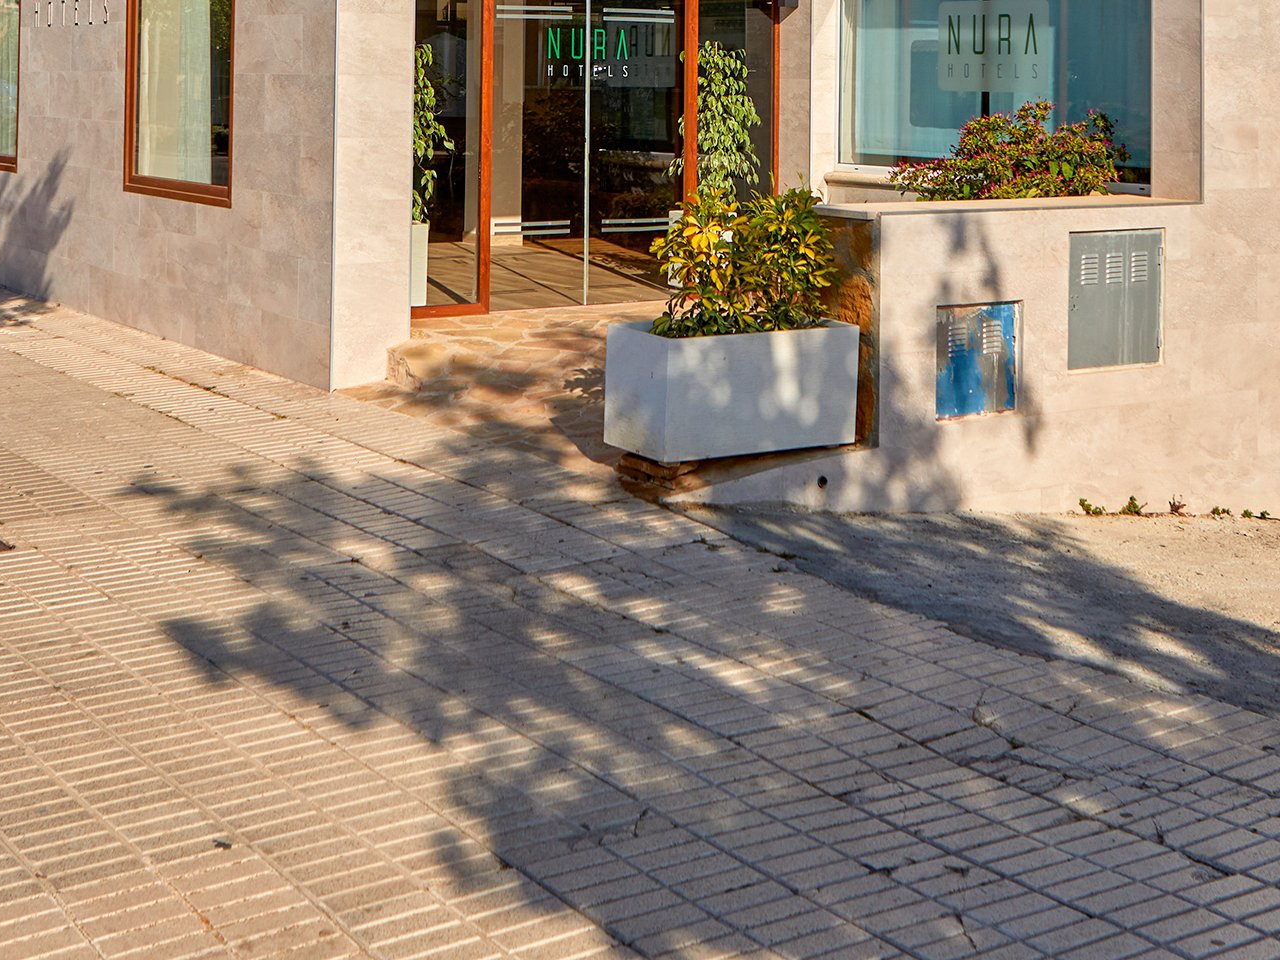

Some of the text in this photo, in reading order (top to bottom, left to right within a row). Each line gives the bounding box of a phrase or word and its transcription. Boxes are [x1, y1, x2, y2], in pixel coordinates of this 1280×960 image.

[547, 27, 629, 61] NURA
[948, 14, 1037, 55] NURA
[547, 64, 629, 78] HOTELS
[948, 63, 1038, 79] HOTELS
